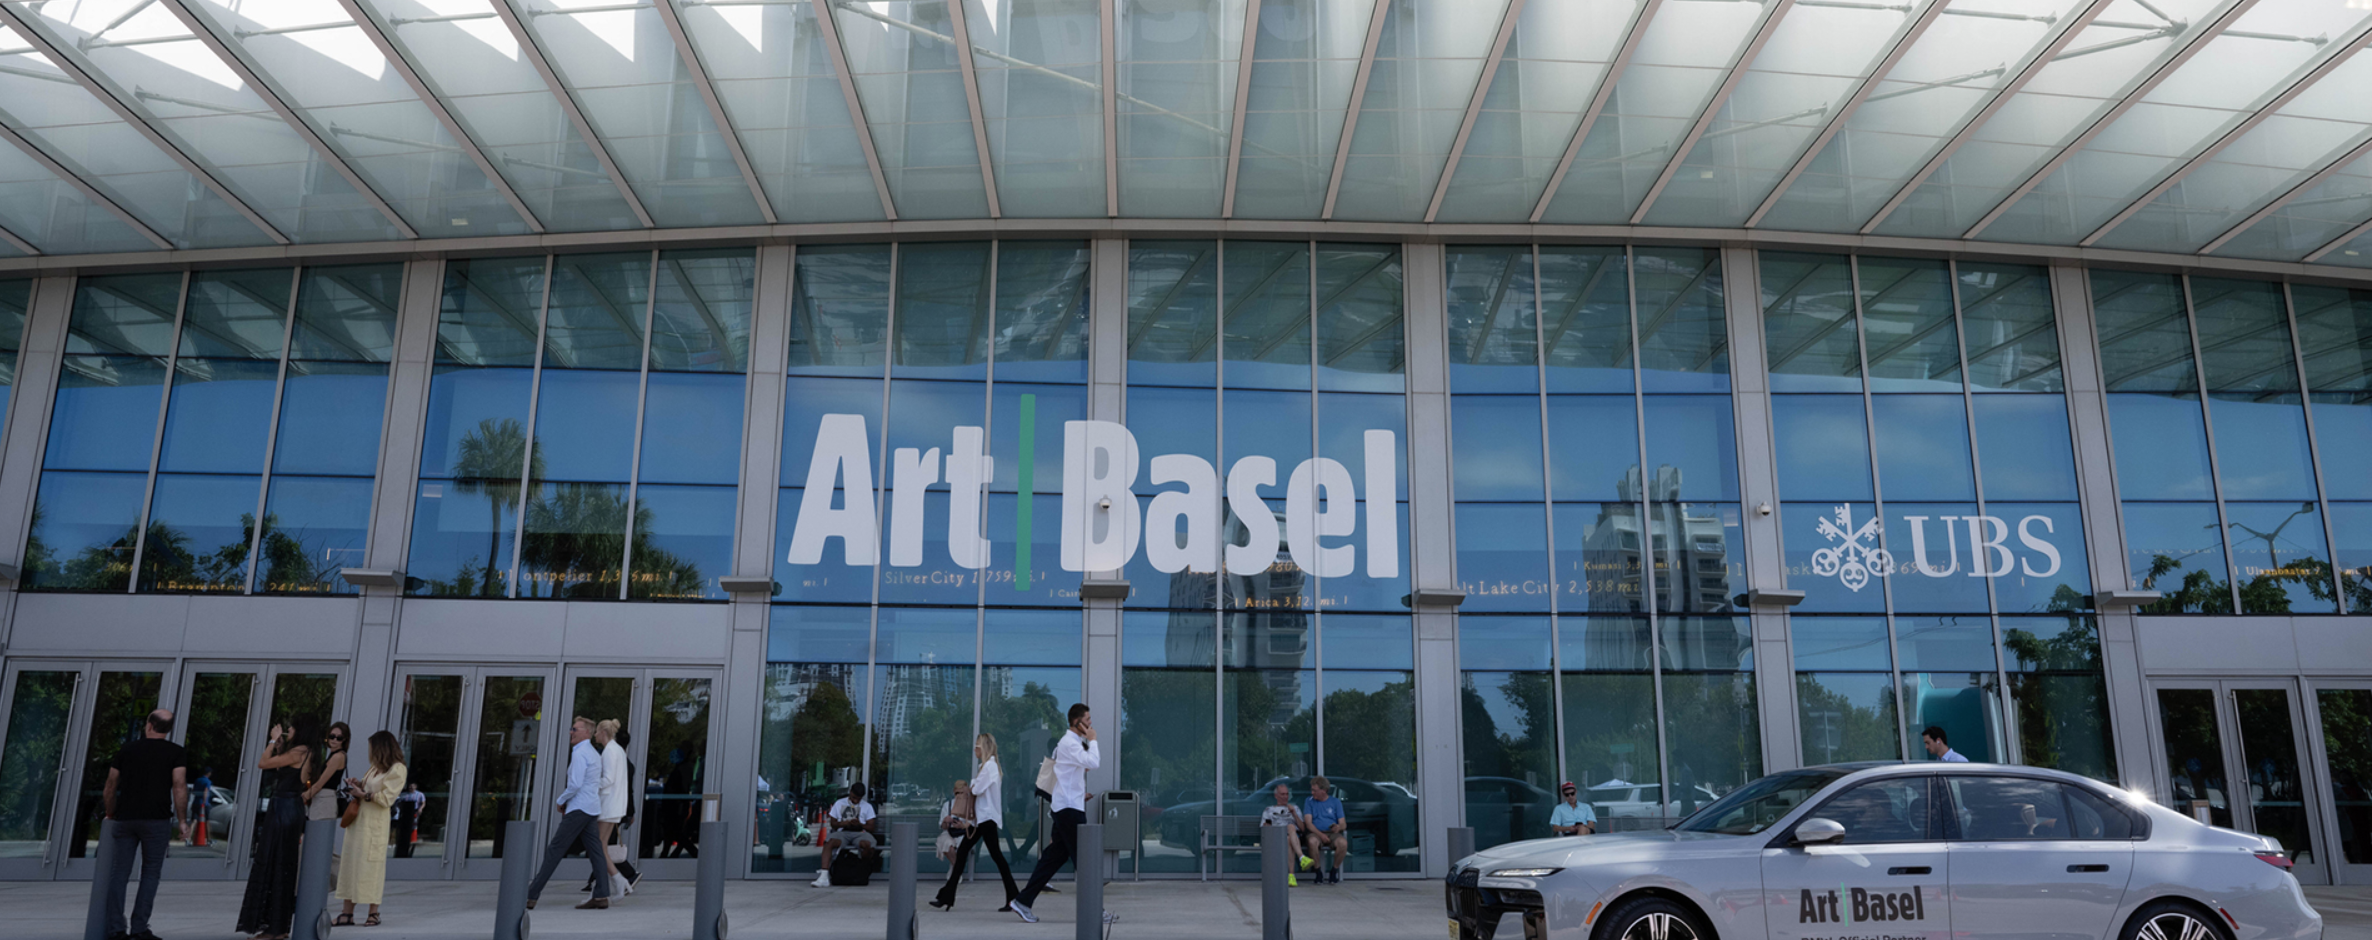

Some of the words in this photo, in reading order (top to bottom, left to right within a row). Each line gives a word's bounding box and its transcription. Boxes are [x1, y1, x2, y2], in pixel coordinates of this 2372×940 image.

[787, 413, 994, 569] Art
[1060, 420, 1399, 578] Basel
[1903, 515, 2061, 578] UBS
[1244, 596, 1280, 608] Arica
[1479, 580, 1519, 596] Lake
[1799, 889, 1840, 923] Art
[1851, 885, 1924, 922] Basel
